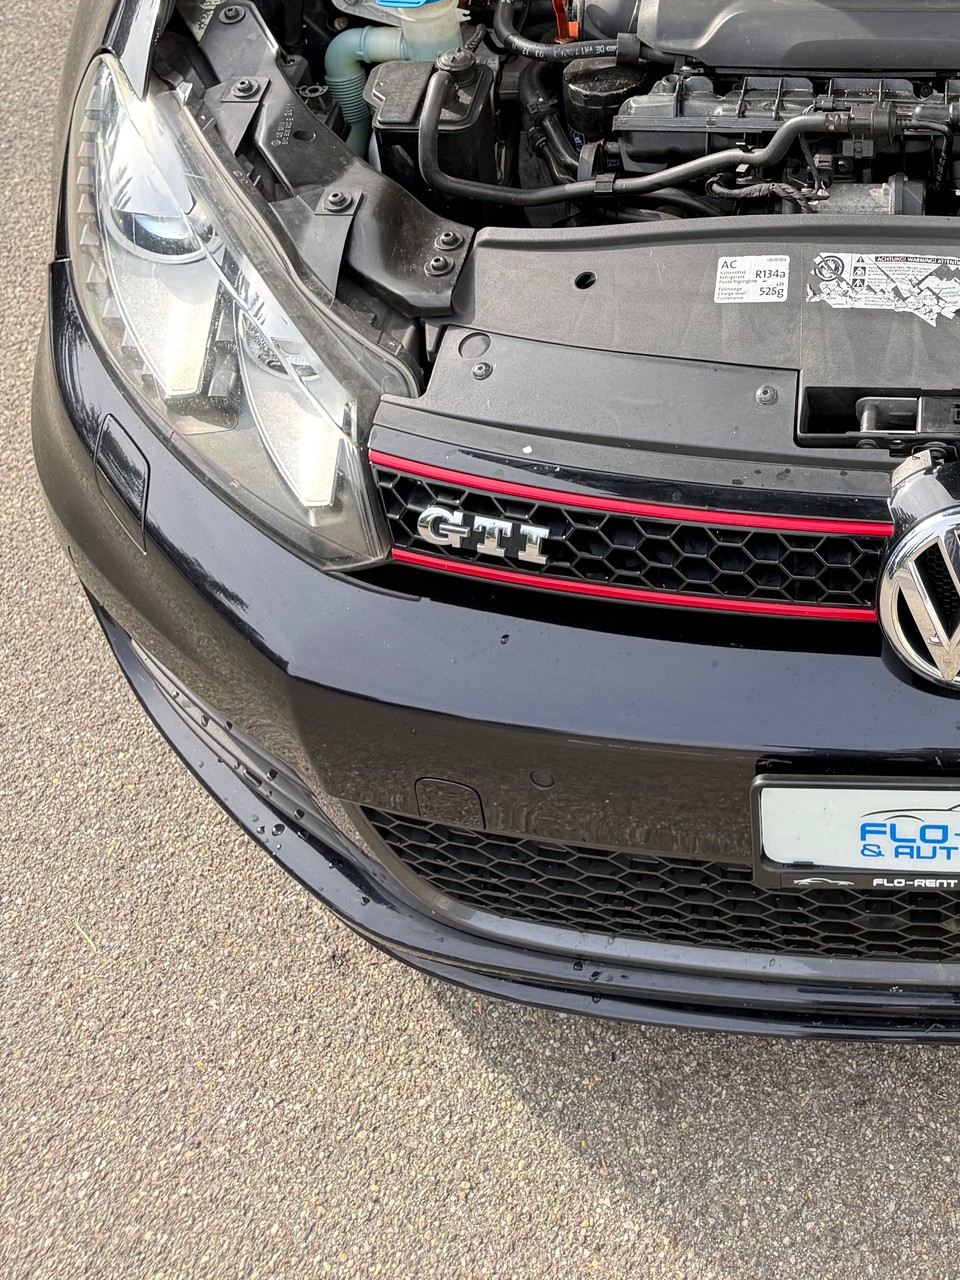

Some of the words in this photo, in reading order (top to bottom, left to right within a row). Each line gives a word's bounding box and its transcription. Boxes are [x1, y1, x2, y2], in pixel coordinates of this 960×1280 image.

[720, 259, 738, 270] AC
[755, 269, 786, 279] R134a
[759, 286, 785, 299] 525g
[416, 505, 551, 566] GTI
[860, 843, 885, 858] &
[872, 877, 958, 889] FLO-RENT
